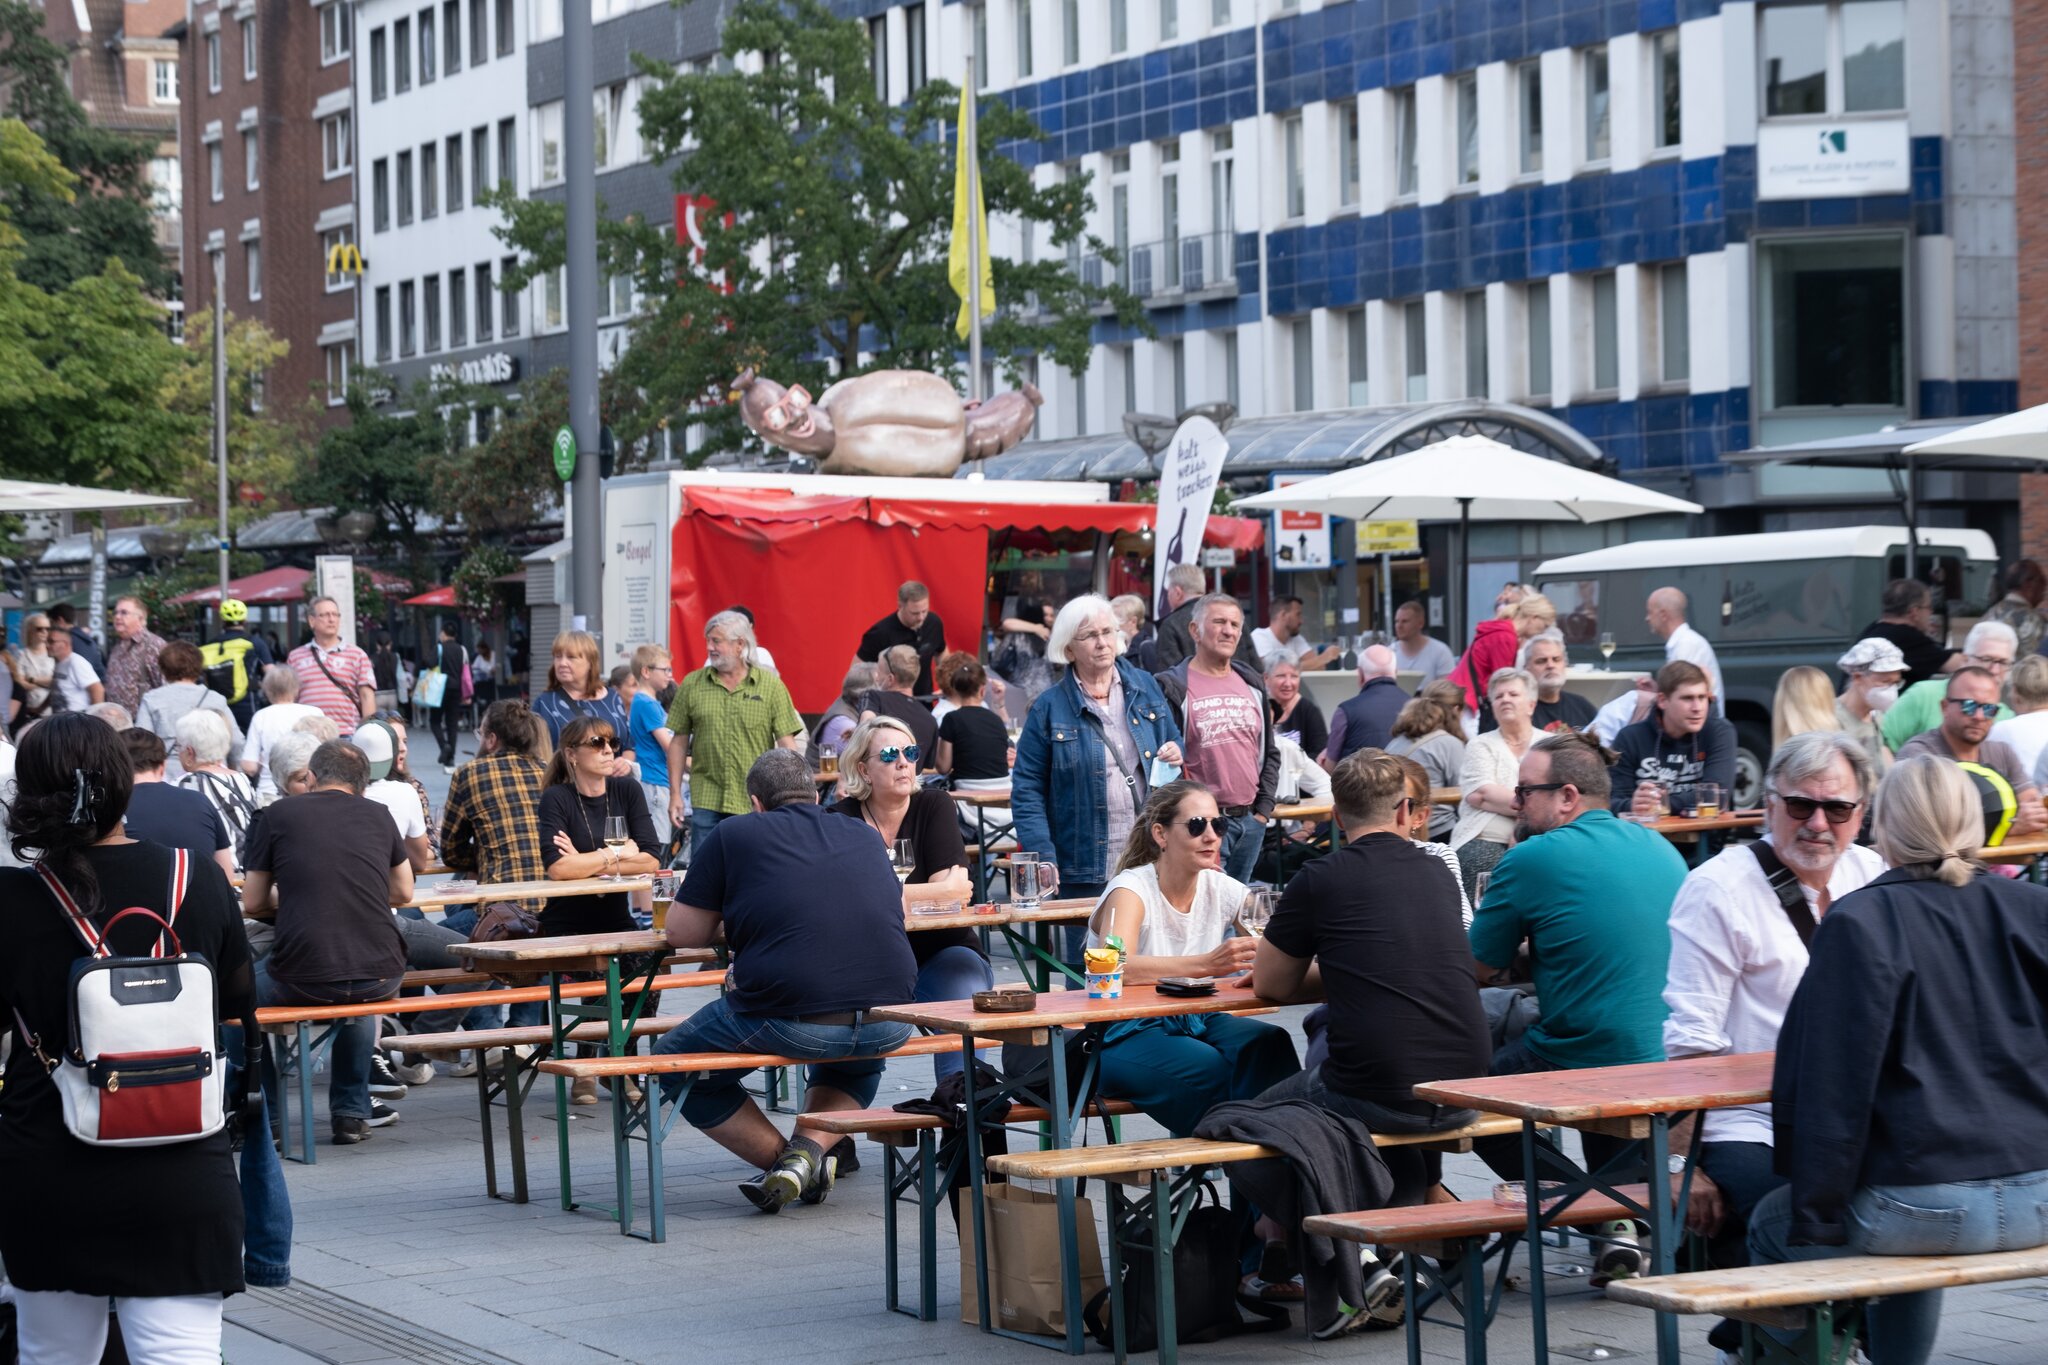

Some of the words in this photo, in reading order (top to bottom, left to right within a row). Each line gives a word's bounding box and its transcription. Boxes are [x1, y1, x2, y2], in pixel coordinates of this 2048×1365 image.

[430, 352, 512, 387] Monald's
[625, 539, 652, 565] Bengel
[1192, 697, 1223, 711] GRAND
